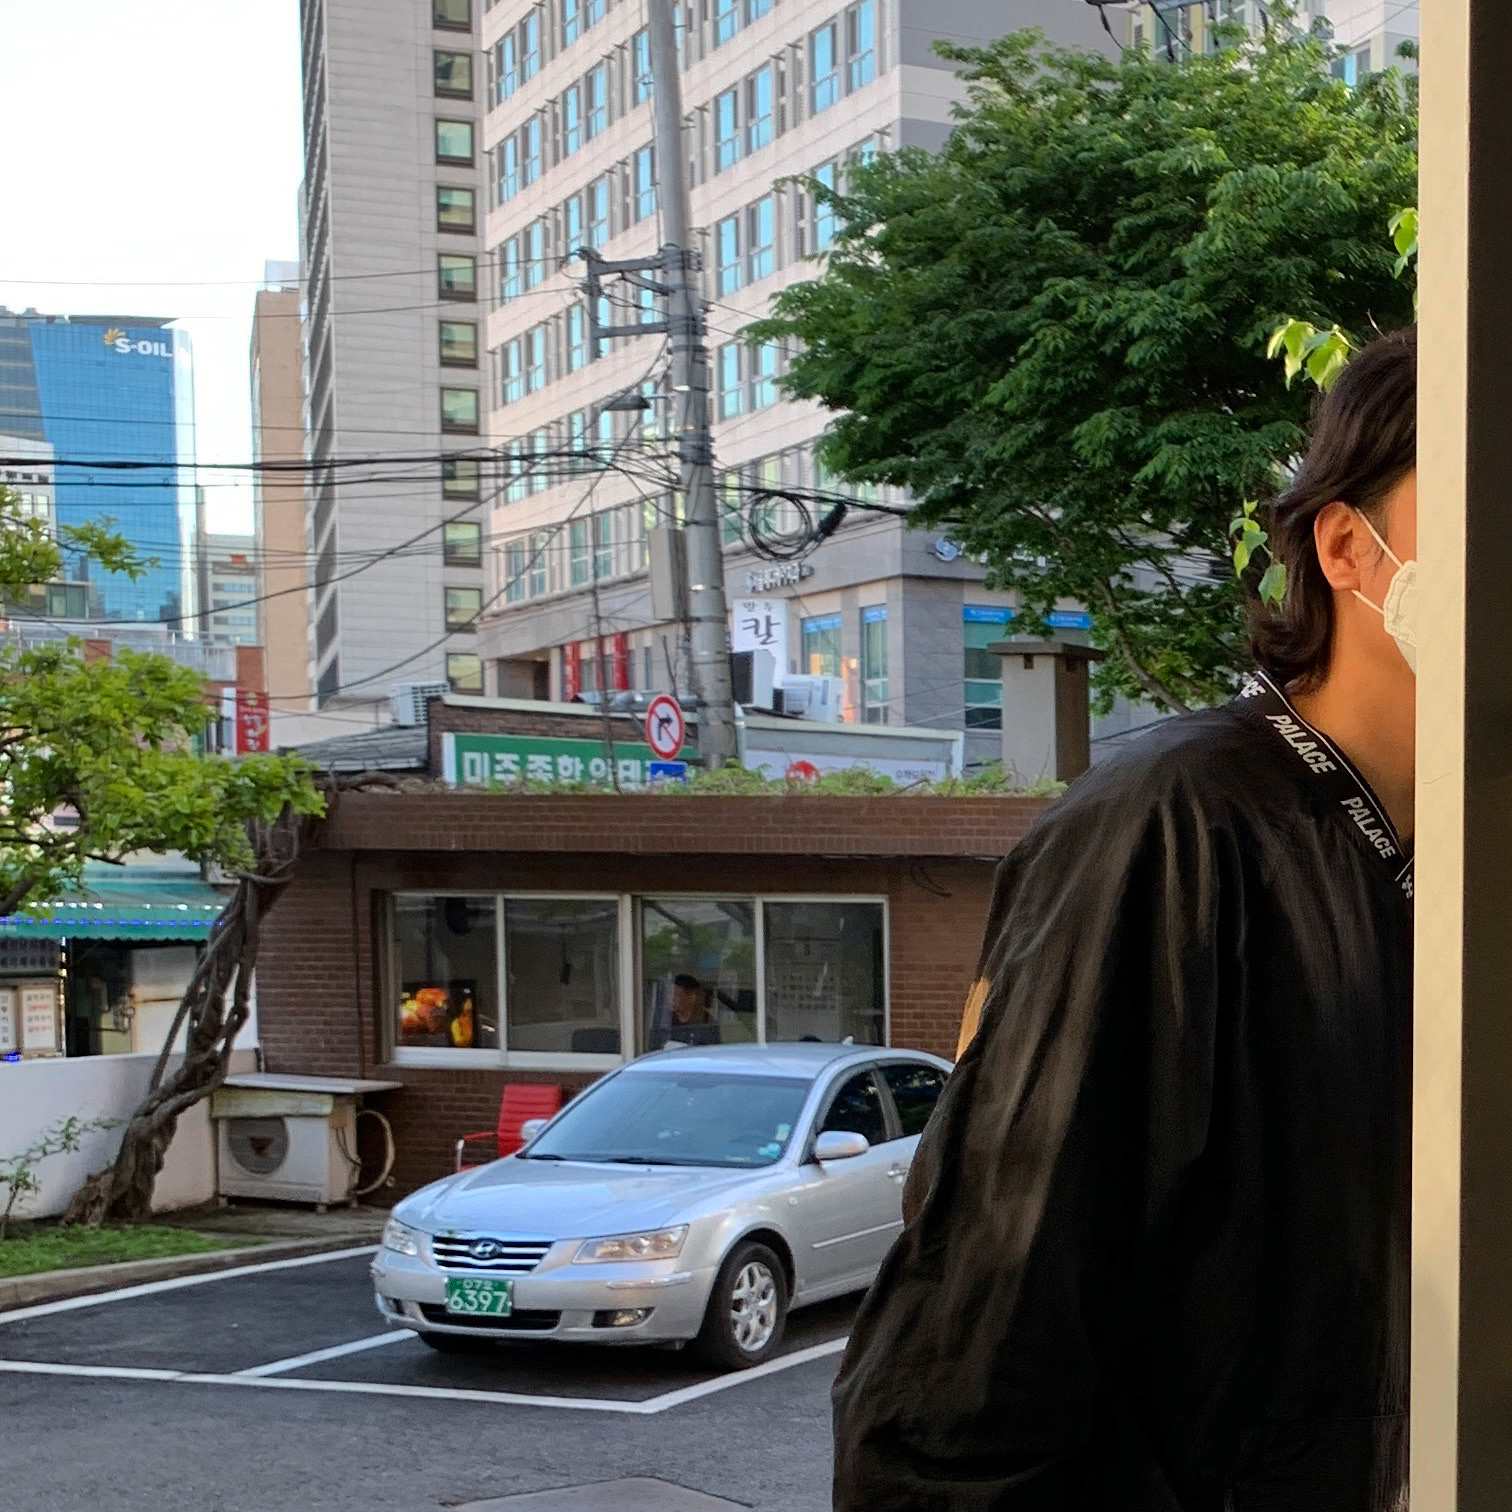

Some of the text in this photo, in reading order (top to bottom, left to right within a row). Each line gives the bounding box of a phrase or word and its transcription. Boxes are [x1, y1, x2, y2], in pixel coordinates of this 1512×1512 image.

[115, 337, 173, 357] S-OIL
[1265, 714, 1337, 774] PALACE
[463, 751, 697, 792] 미주종합인테
[1340, 796, 1396, 859] PALACE
[450, 1289, 508, 1313] 6397
